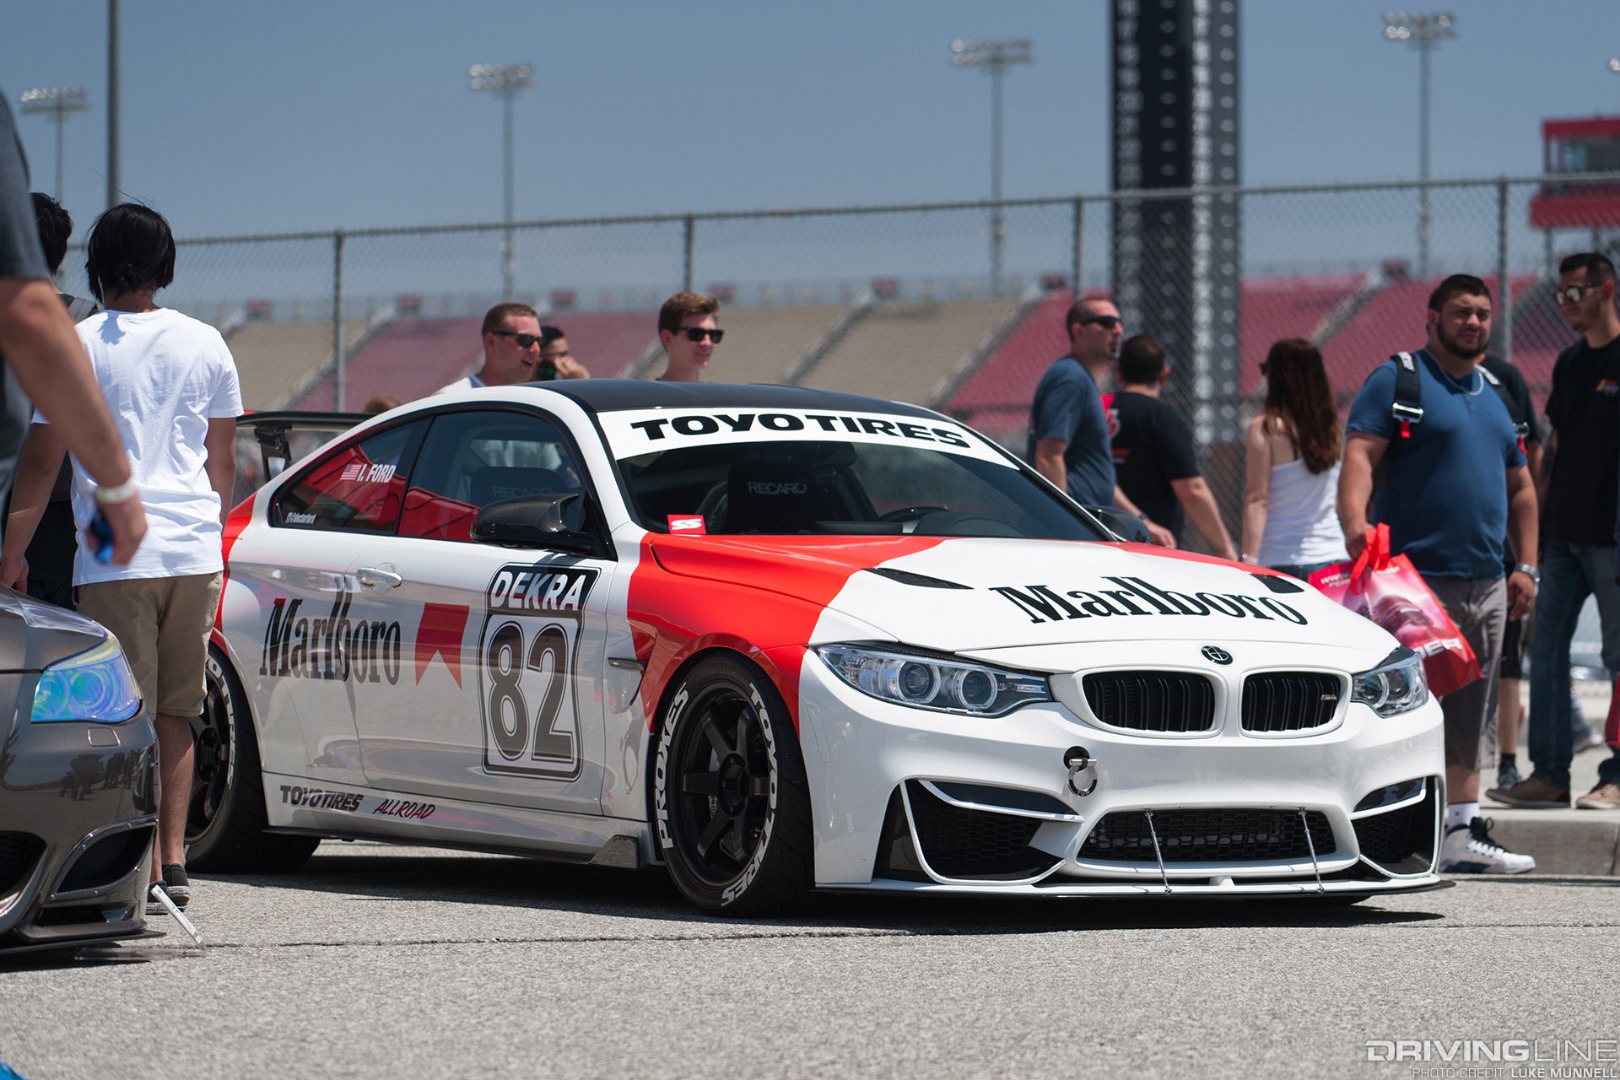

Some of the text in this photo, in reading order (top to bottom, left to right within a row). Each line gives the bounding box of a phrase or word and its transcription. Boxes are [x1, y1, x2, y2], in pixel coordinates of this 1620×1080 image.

[366, 464, 397, 483] FORD
[490, 570, 588, 612] DEKRA
[987, 575, 1308, 626] Marlboro
[258, 578, 402, 686] Marlboro
[486, 620, 576, 765] 82
[653, 681, 689, 849] PROXES
[372, 798, 436, 819] ALLROAD
